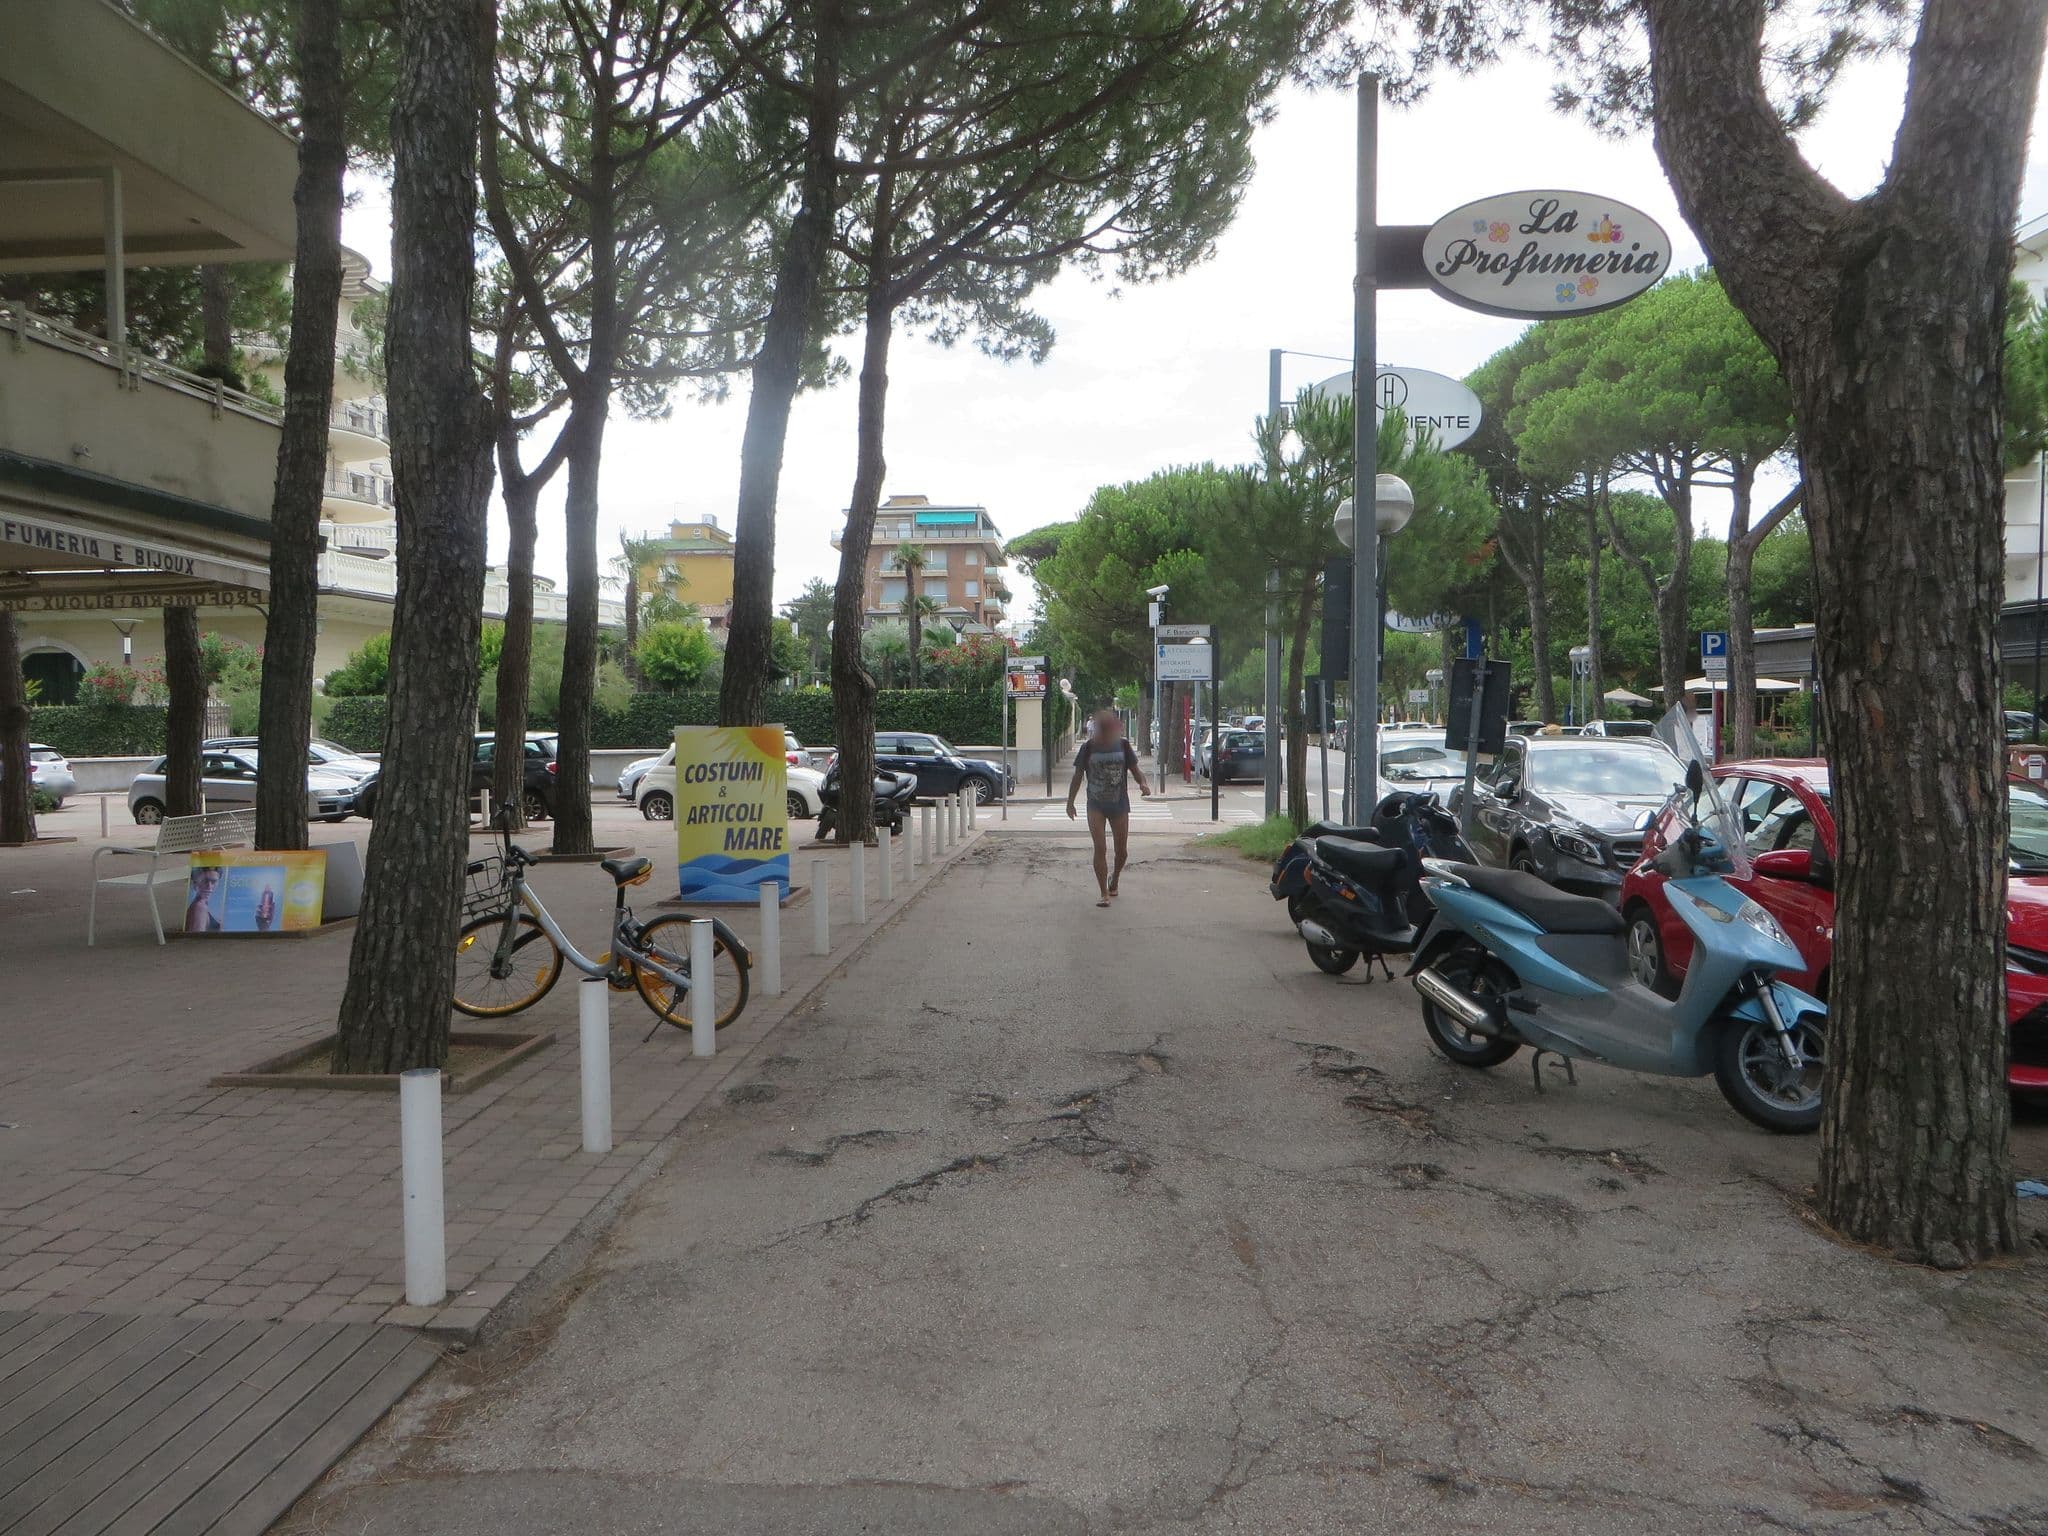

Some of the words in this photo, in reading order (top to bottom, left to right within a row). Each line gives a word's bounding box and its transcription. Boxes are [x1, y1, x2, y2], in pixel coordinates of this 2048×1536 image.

[1519, 198, 1578, 234] La
[1435, 239, 1659, 286] Profumeria
[114, 543, 123, 561] E
[136, 549, 195, 575] BIJOUX
[1707, 635, 1722, 655] P
[685, 762, 763, 783] COSTUMI
[718, 786, 727, 798] &
[687, 803, 763, 825] ARTICOLI
[724, 828, 783, 851] MARE
